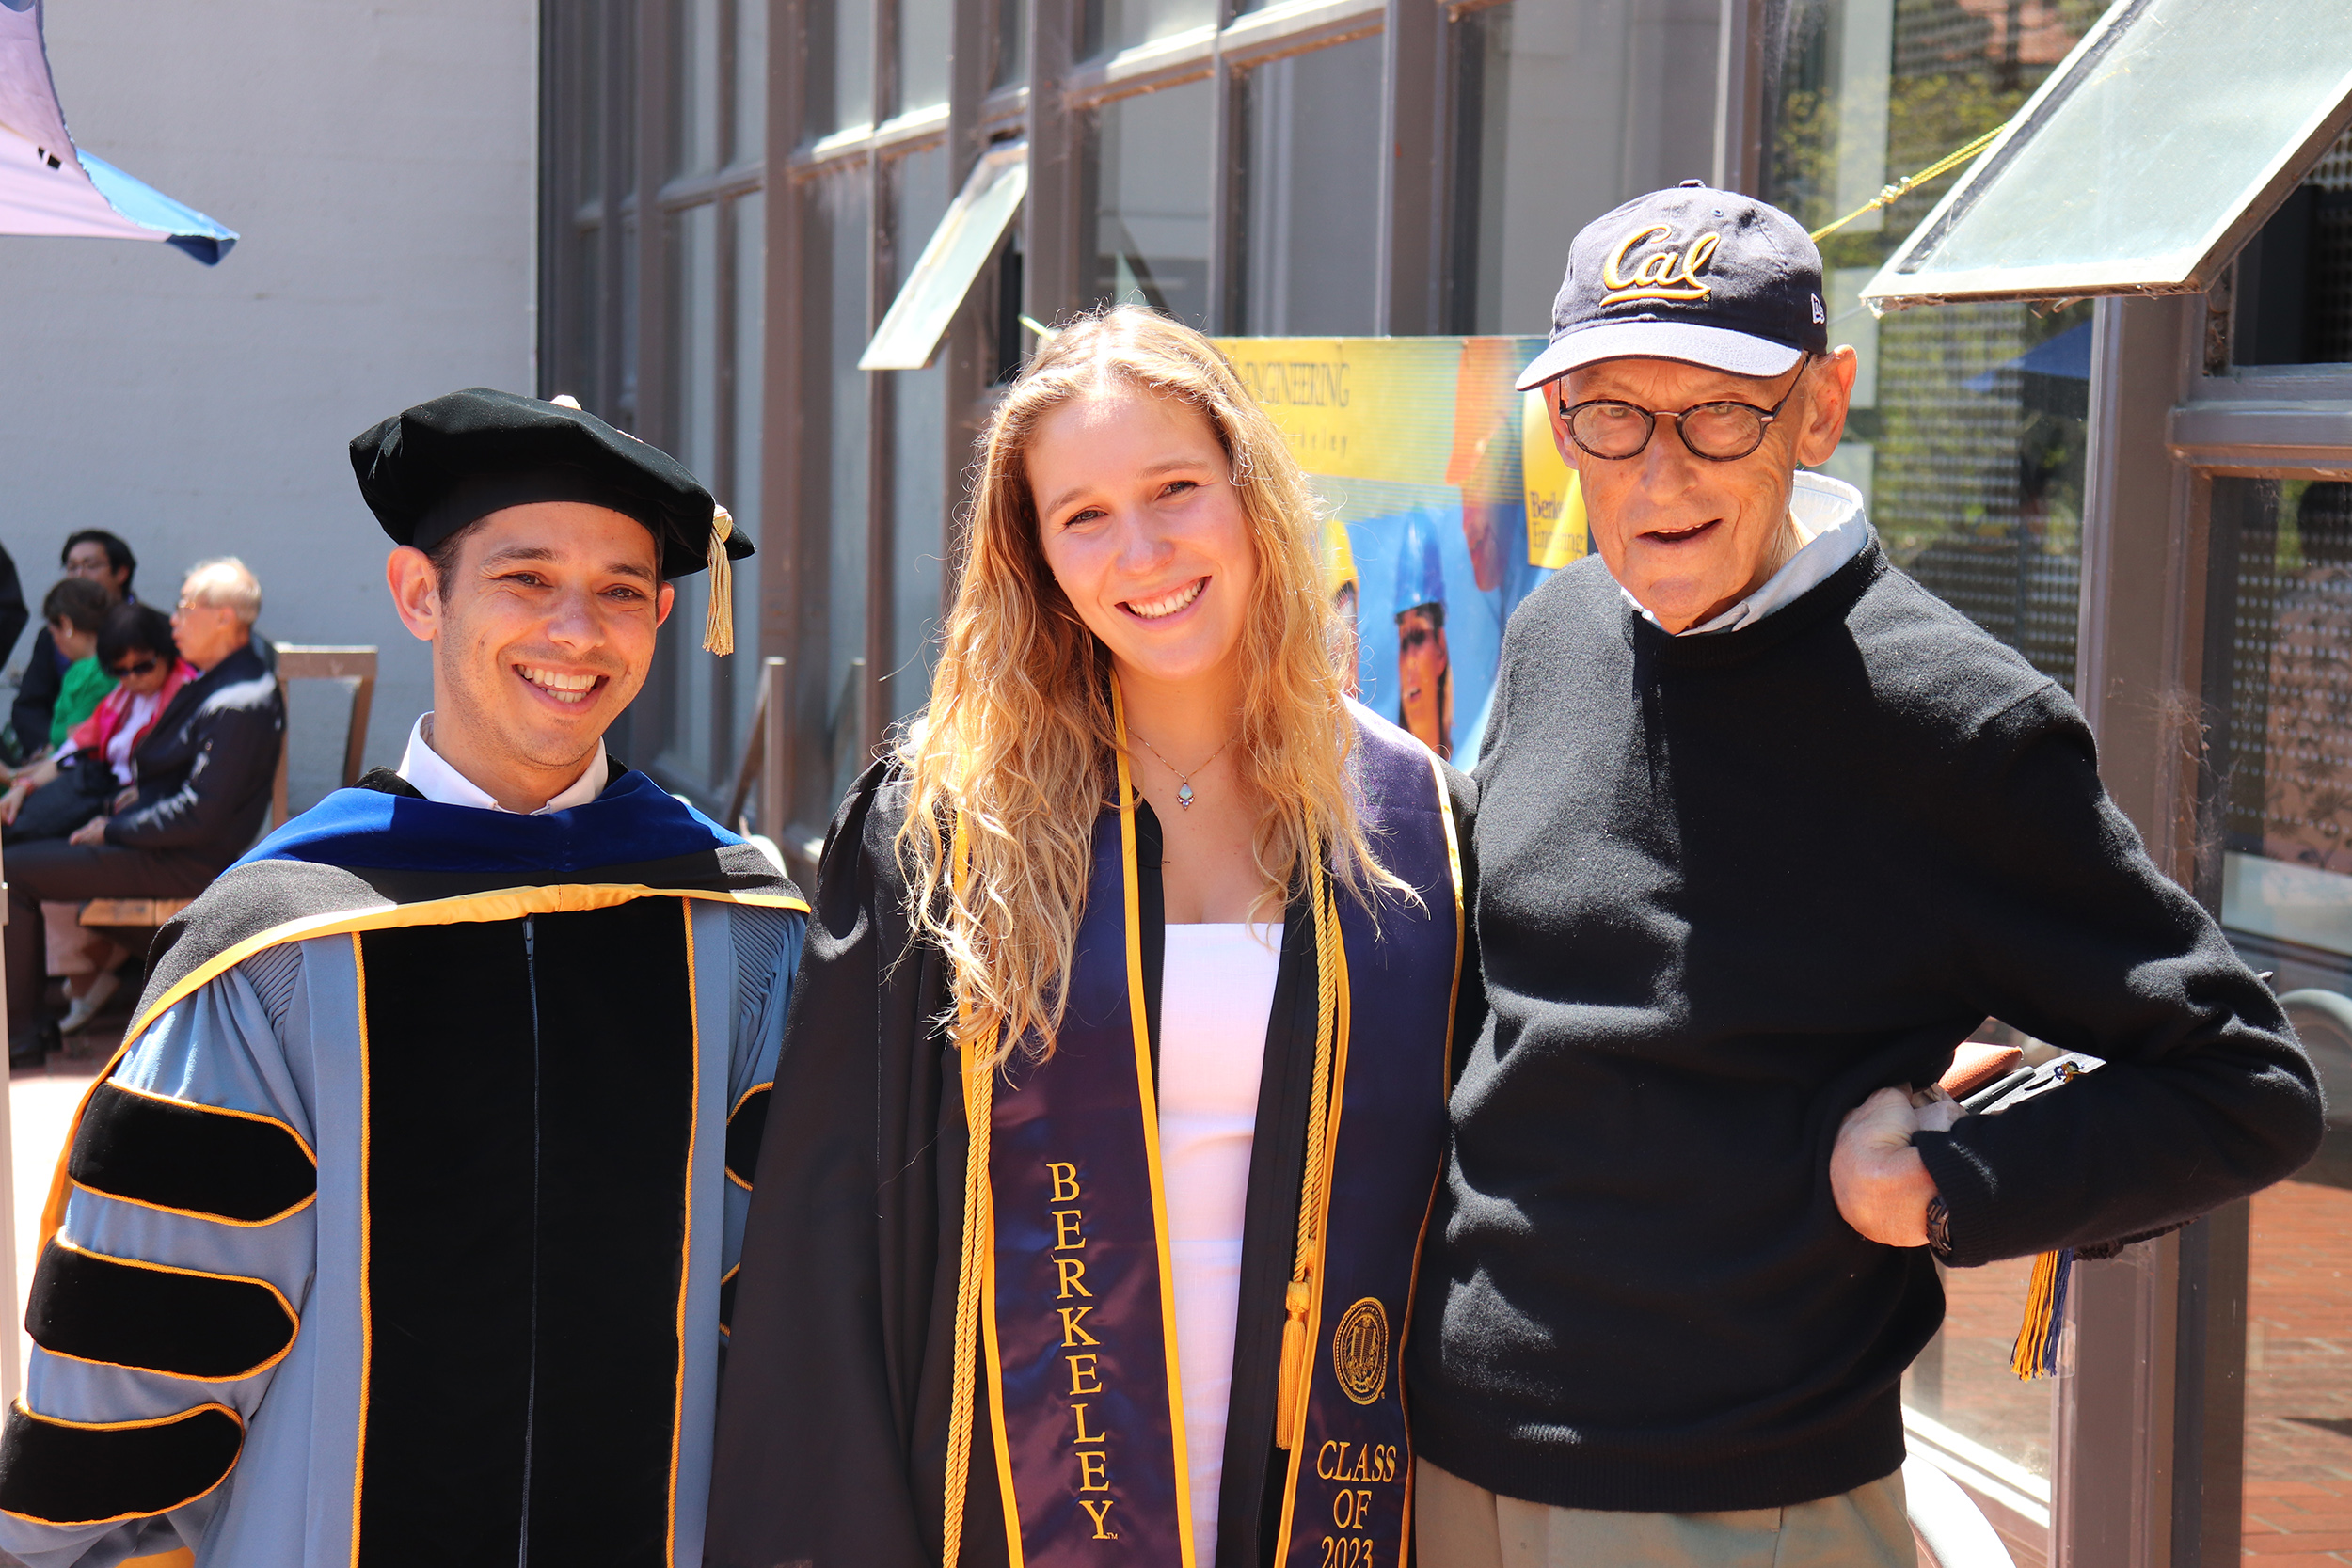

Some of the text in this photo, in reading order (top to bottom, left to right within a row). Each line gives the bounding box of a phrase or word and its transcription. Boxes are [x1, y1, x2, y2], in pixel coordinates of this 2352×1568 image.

[1600, 223, 1721, 306] Cal
[1046, 1162, 1114, 1540] BERKELEY
[1317, 1439, 1397, 1483] CLASS
[1333, 1488, 1373, 1529] OF
[1321, 1535, 1375, 1568] 2023
